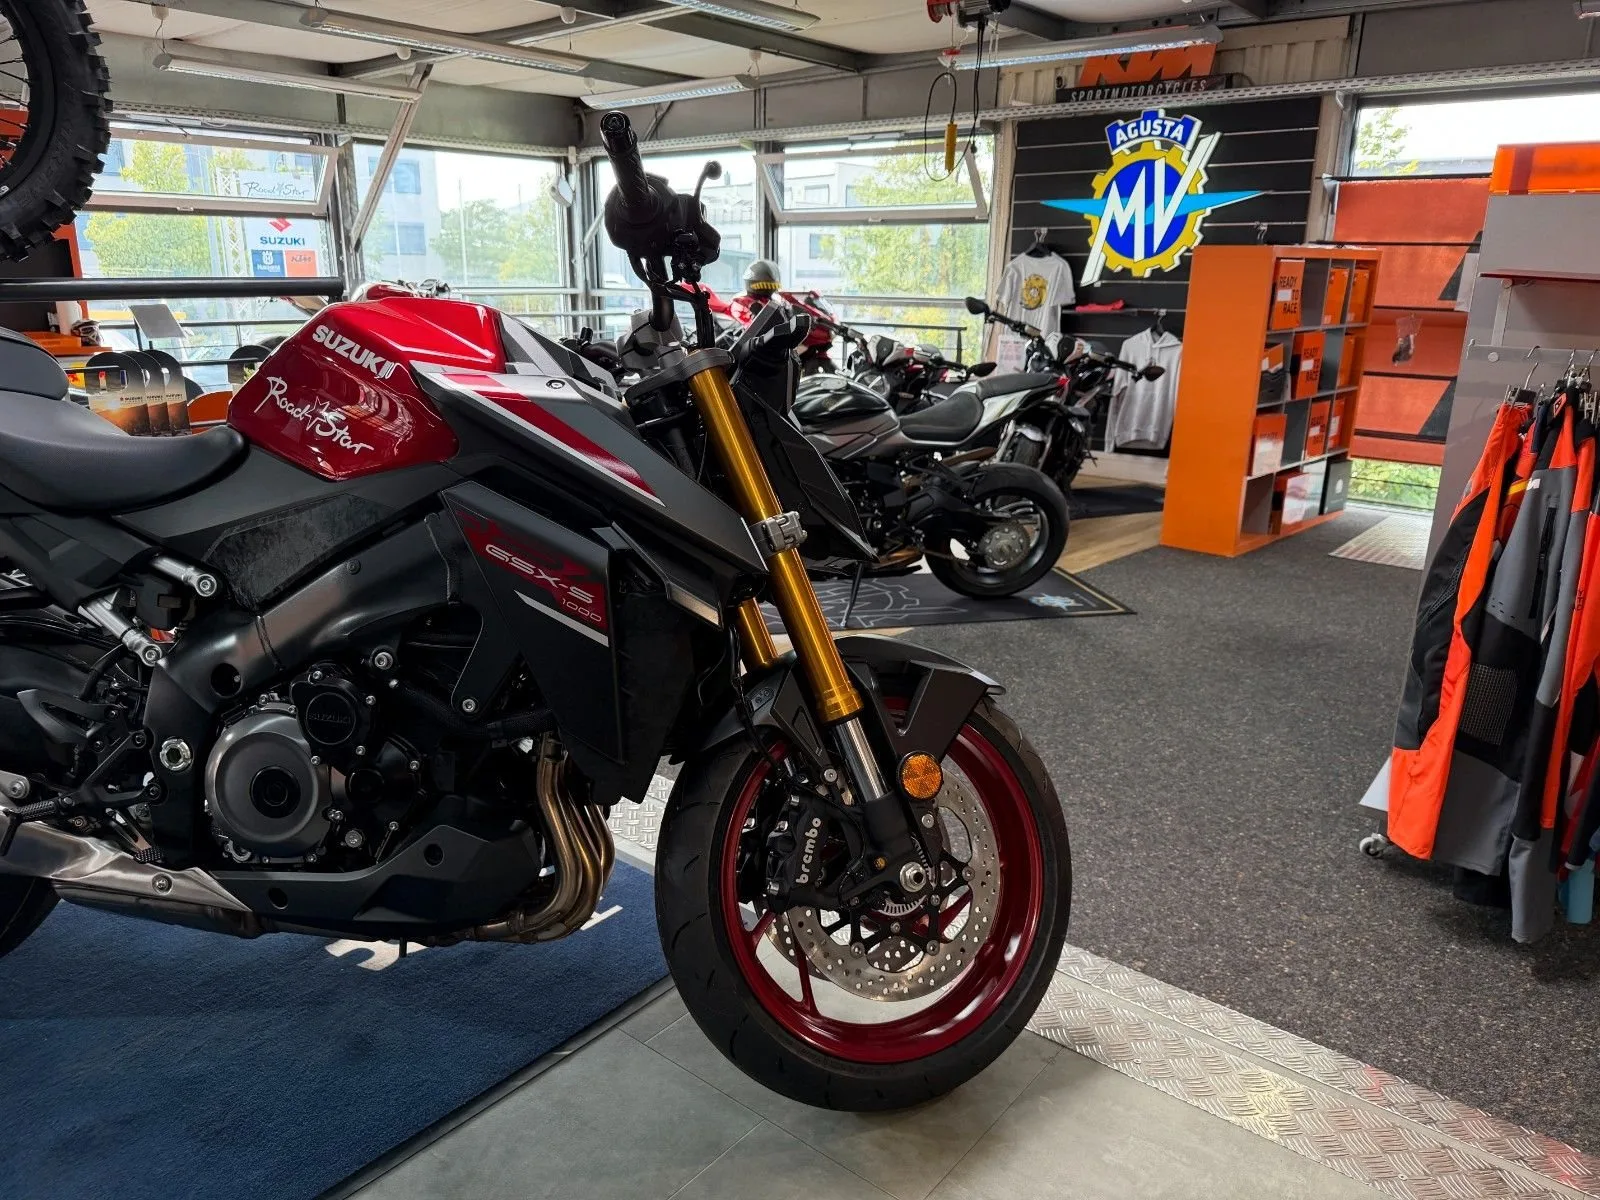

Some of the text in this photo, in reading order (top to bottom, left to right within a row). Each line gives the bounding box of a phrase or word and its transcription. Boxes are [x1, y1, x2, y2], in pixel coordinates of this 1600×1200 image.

[1079, 44, 1217, 87] KTM
[1070, 79, 1207, 101] SPORTMOTORCYCLES
[1115, 119, 1185, 146] AGUSTA
[1080, 132, 1221, 287] MV
[260, 236, 305, 246] SUZUKI
[1279, 275, 1297, 288] READY
[1282, 302, 1297, 314] RACE
[312, 325, 395, 379] SUZUKI
[254, 376, 375, 455] Road Star
[485, 543, 595, 604] GSX-S
[562, 597, 602, 623] 1000
[795, 817, 822, 884] brembo
